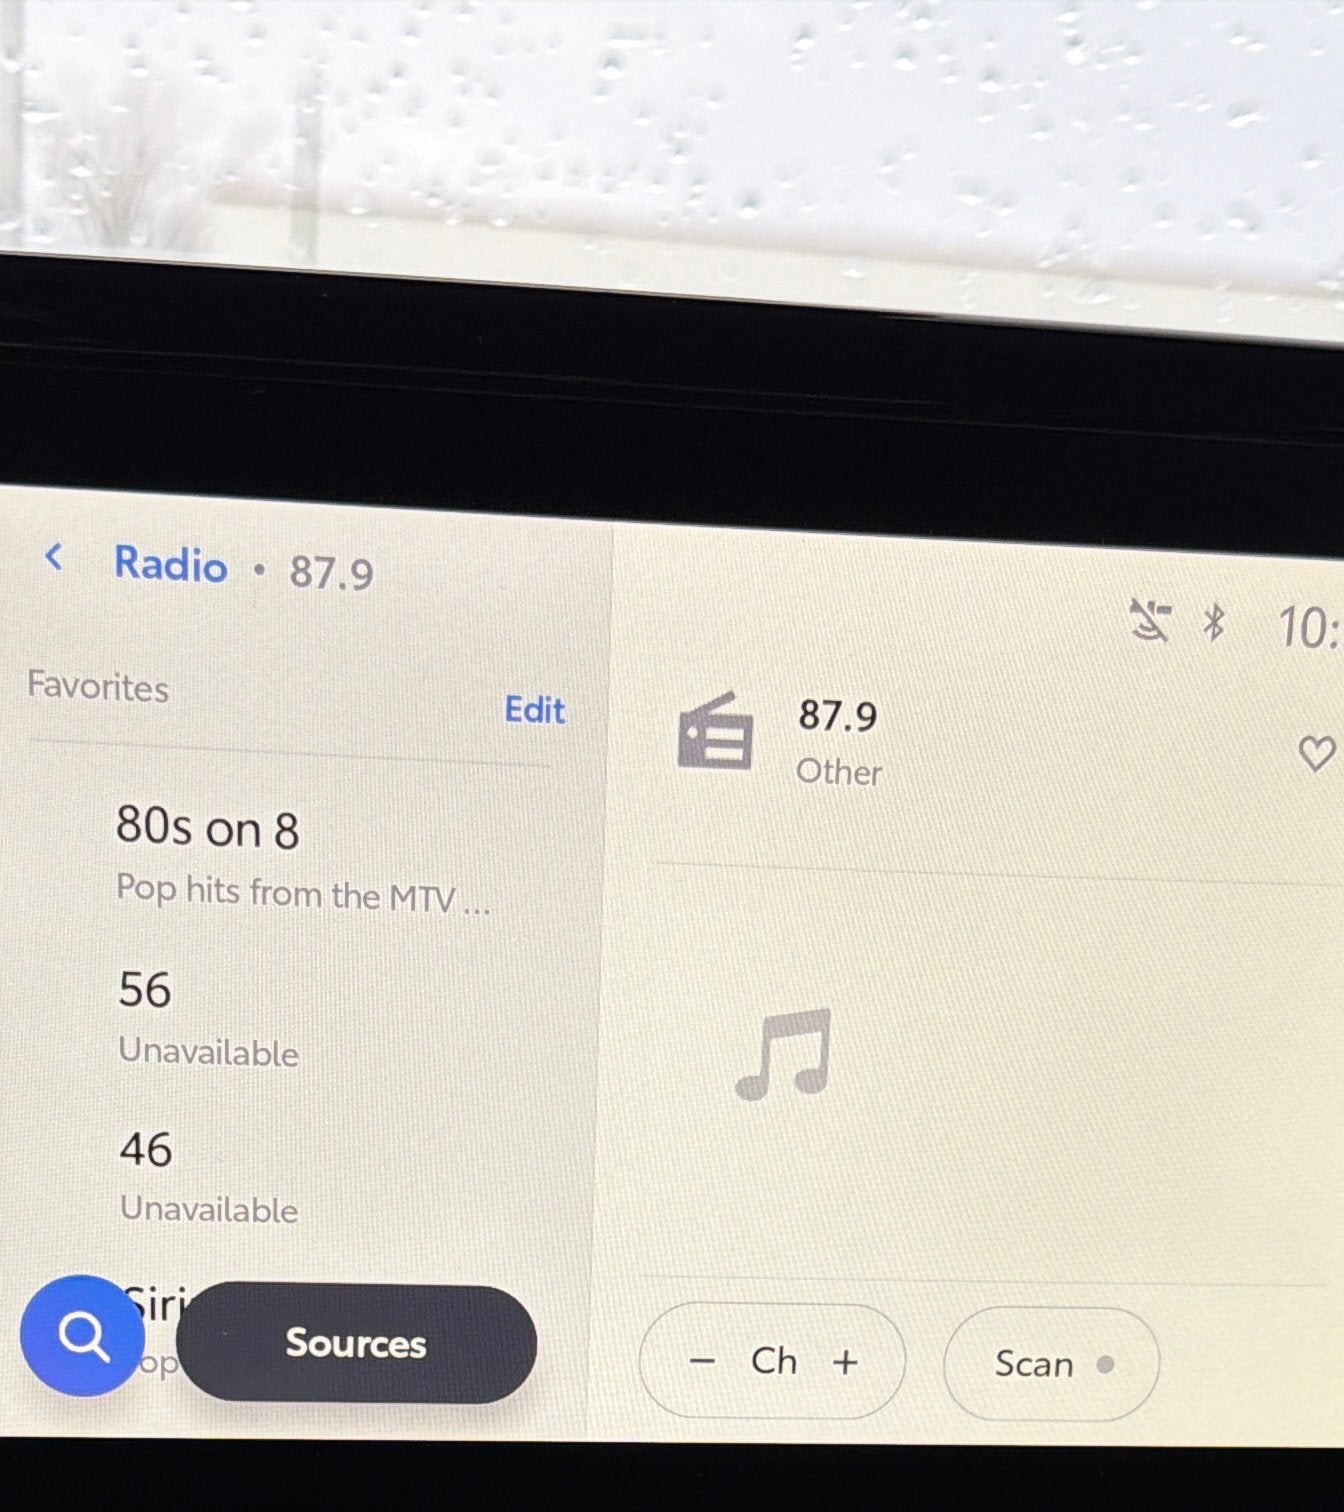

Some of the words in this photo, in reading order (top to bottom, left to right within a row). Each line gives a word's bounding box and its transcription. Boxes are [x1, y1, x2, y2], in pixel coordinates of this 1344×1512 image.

[114, 543, 228, 584] Radio
[290, 555, 375, 590] 87.9
[28, 668, 169, 704] Favorites
[504, 694, 567, 725] Edit
[798, 698, 878, 734] 87.9
[796, 756, 884, 788] Other
[115, 804, 192, 847] 80s
[205, 815, 262, 849] on
[274, 811, 301, 850] 8
[116, 872, 177, 911] Pop
[187, 873, 240, 905] hits
[250, 875, 323, 909] from
[332, 881, 381, 911] the
[390, 885, 457, 915] MTV
[119, 970, 172, 1009] 56
[118, 1035, 300, 1069] Unavailable
[119, 1130, 173, 1168] 46
[120, 1193, 299, 1225] Unavailable
[285, 1325, 428, 1361] Sources
[751, 1344, 798, 1376] Ch
[140, 1355, 179, 1382] op
[995, 1348, 1075, 1379] Scan
